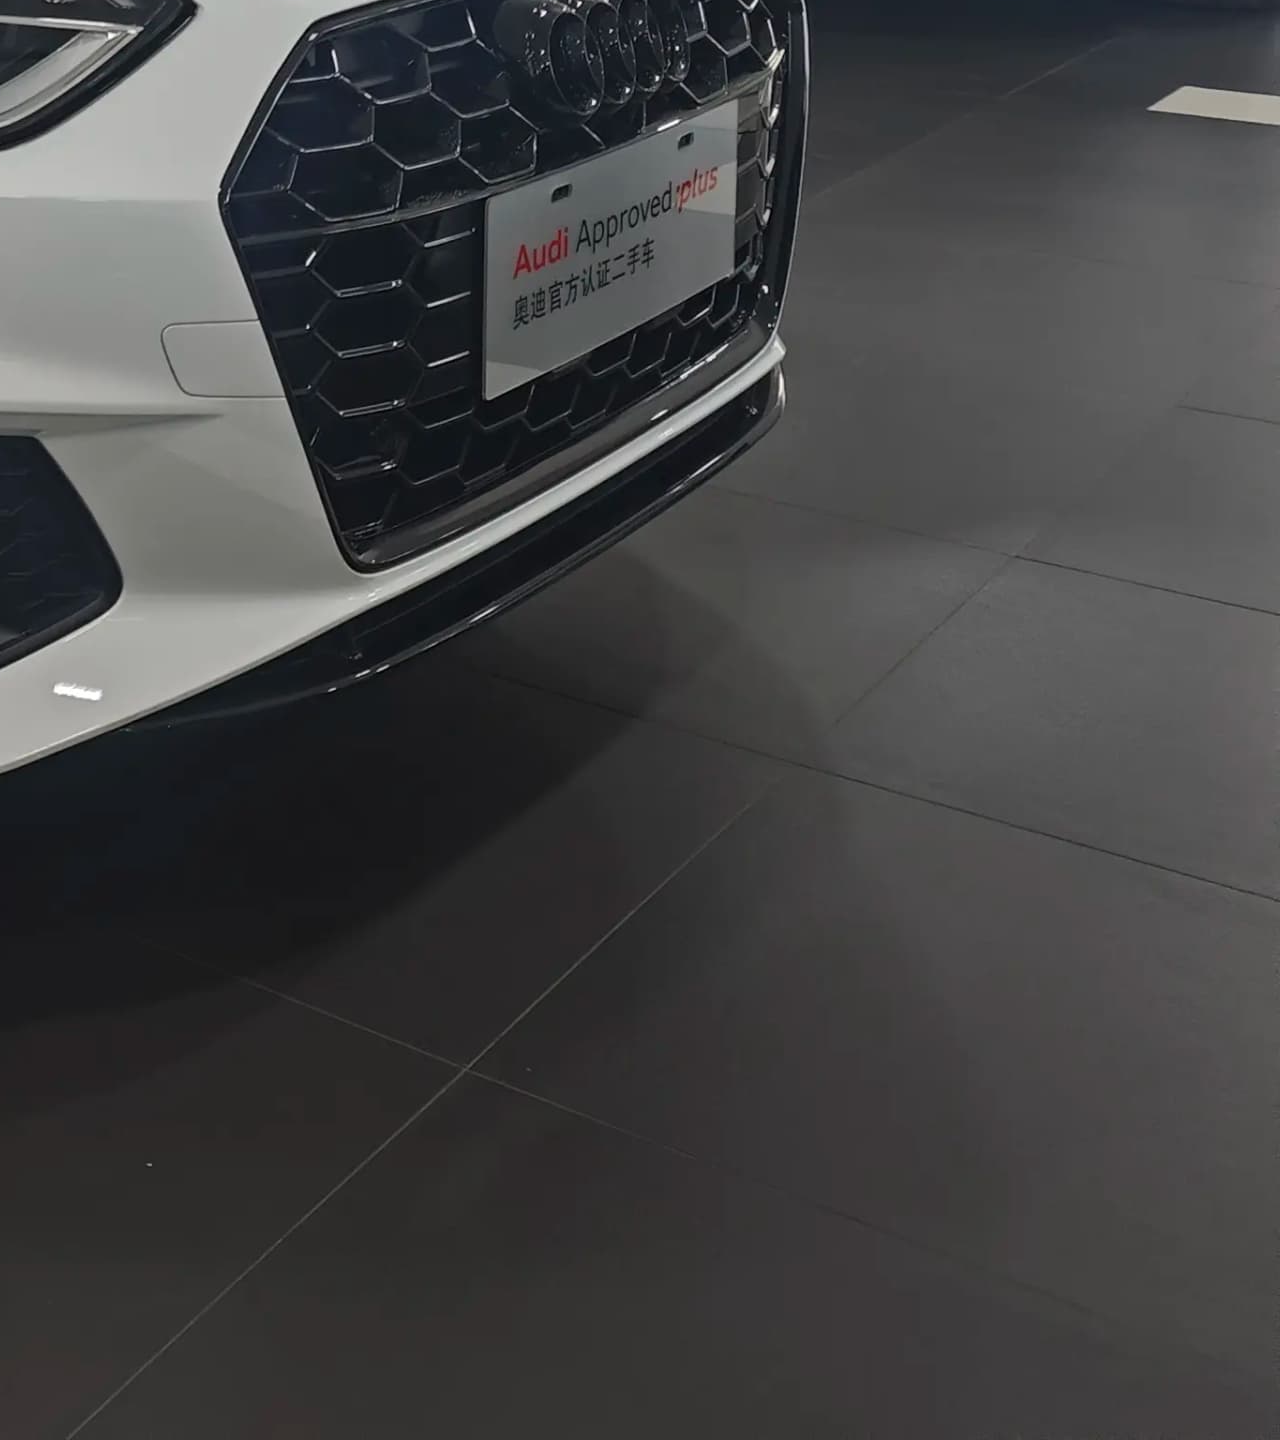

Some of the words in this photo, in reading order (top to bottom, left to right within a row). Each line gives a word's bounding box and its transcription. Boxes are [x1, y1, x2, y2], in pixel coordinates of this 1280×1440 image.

[512, 227, 569, 279] Audi
[512, 237, 656, 330] 奥迪官方认证二手车
